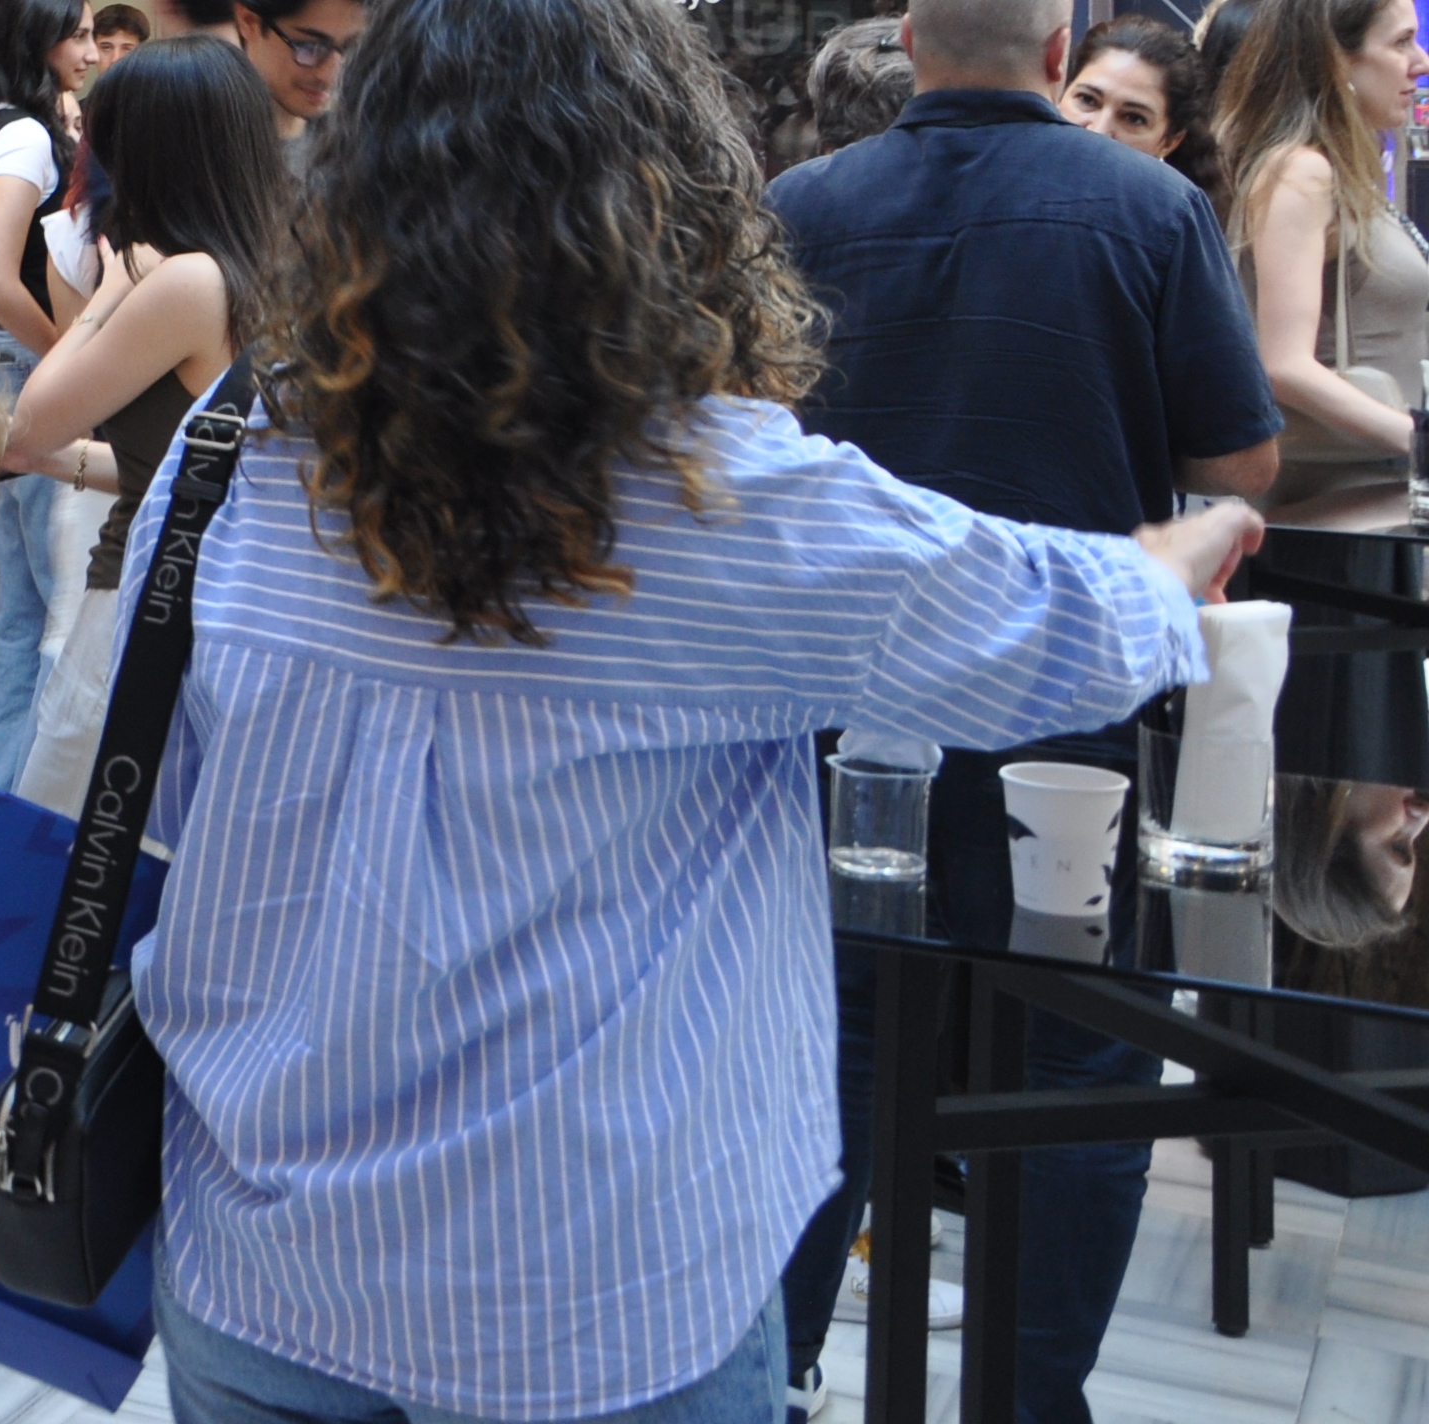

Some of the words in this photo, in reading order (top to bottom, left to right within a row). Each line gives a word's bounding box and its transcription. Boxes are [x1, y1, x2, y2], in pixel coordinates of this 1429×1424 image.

[144, 529, 200, 624] Klein
[75, 755, 141, 889] Calvin
[48, 895, 108, 998] Klein
